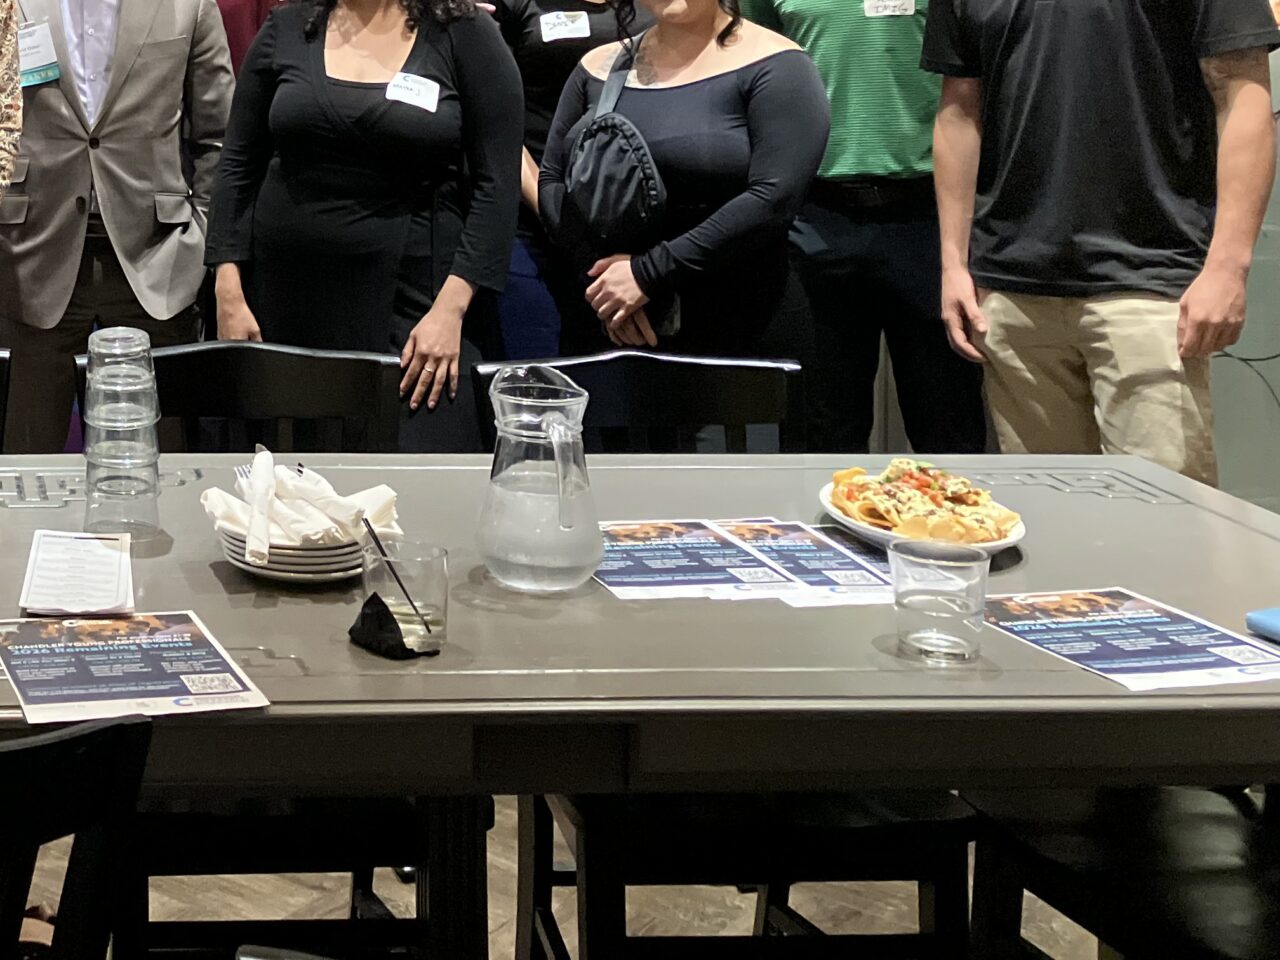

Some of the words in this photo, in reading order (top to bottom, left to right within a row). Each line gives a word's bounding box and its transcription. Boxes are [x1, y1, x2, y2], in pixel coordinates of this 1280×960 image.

[7, 643, 65, 651] CHANDLER
[67, 640, 106, 648] YOUNG
[54, 644, 139, 654] Remaining
[142, 641, 193, 650] Events
